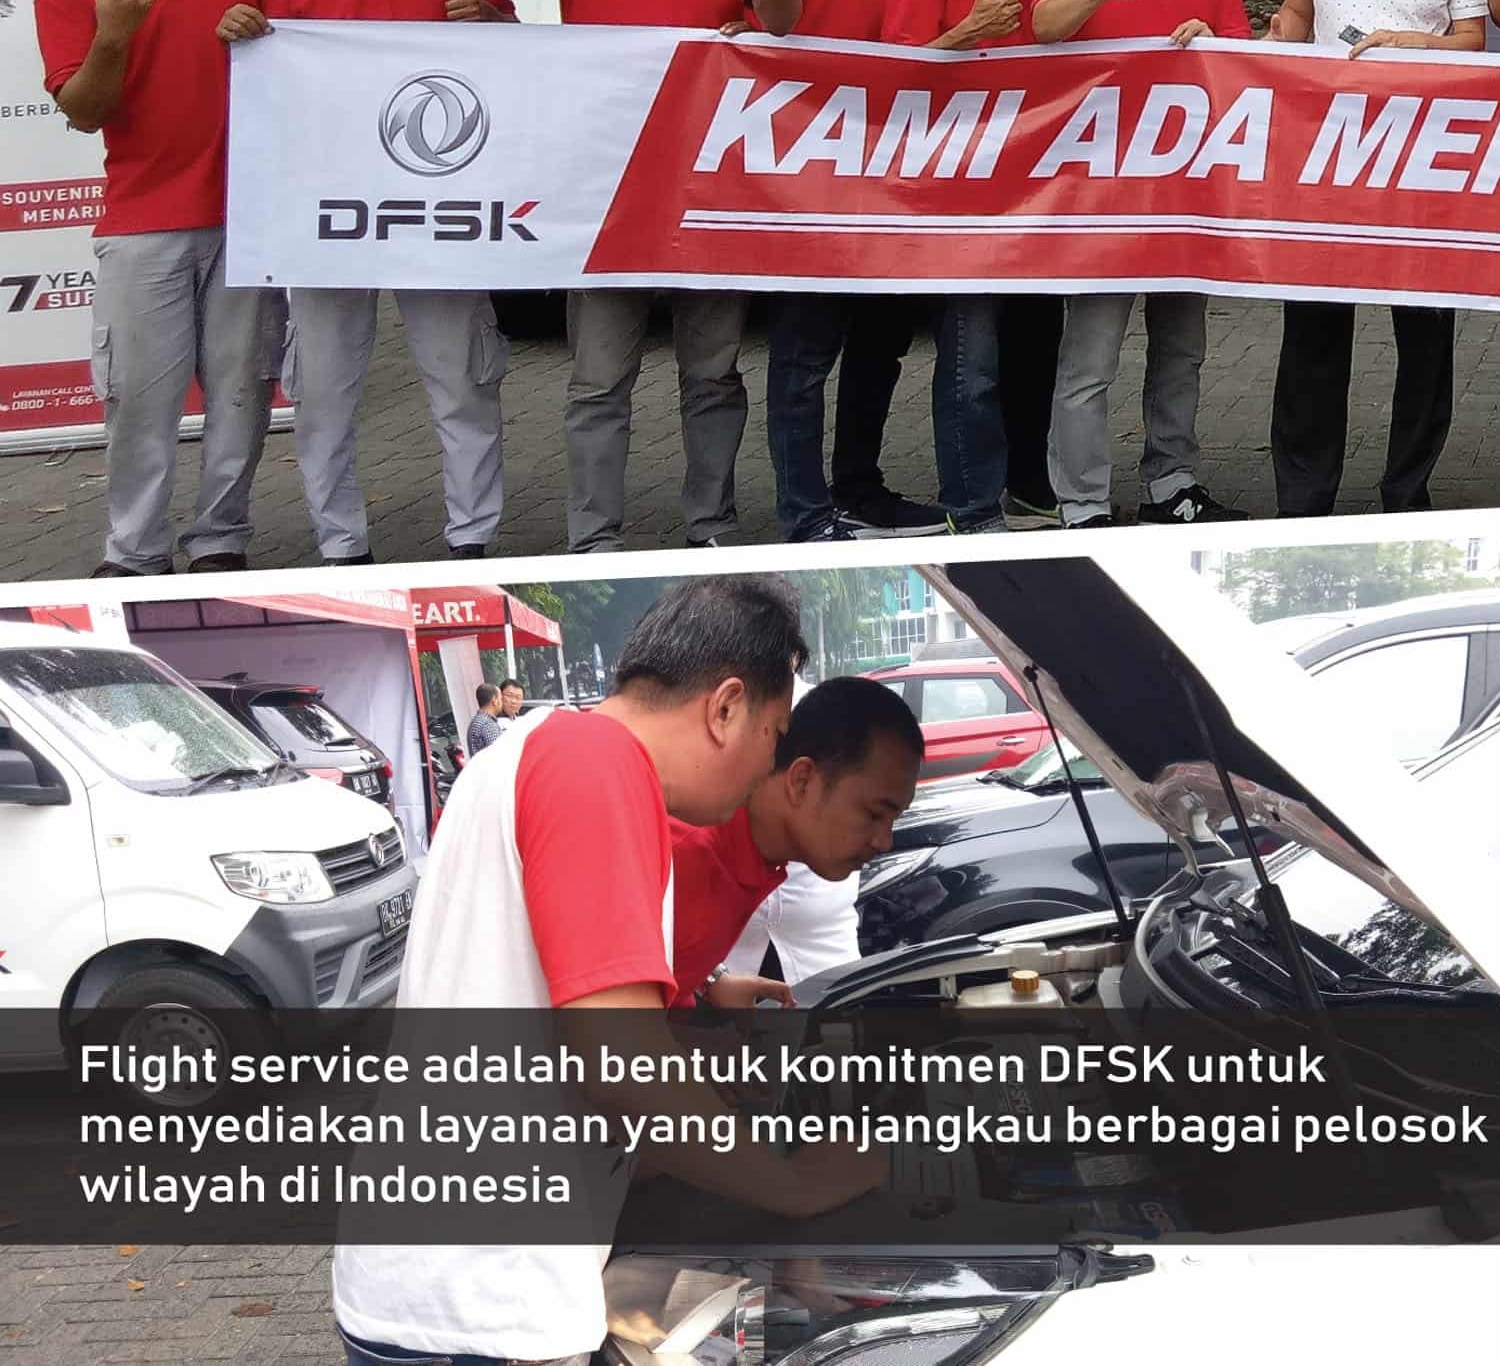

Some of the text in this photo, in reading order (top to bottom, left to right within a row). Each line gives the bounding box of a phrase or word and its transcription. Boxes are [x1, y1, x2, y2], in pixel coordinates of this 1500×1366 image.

[693, 77, 1026, 179] KAMI
[1029, 84, 1274, 183] ADA
[2, 186, 104, 205] SOUVENIR
[23, 205, 107, 223] MENARI
[318, 200, 541, 241] DFSK
[1, 275, 41, 312] 7
[51, 386, 73, 395] CALL
